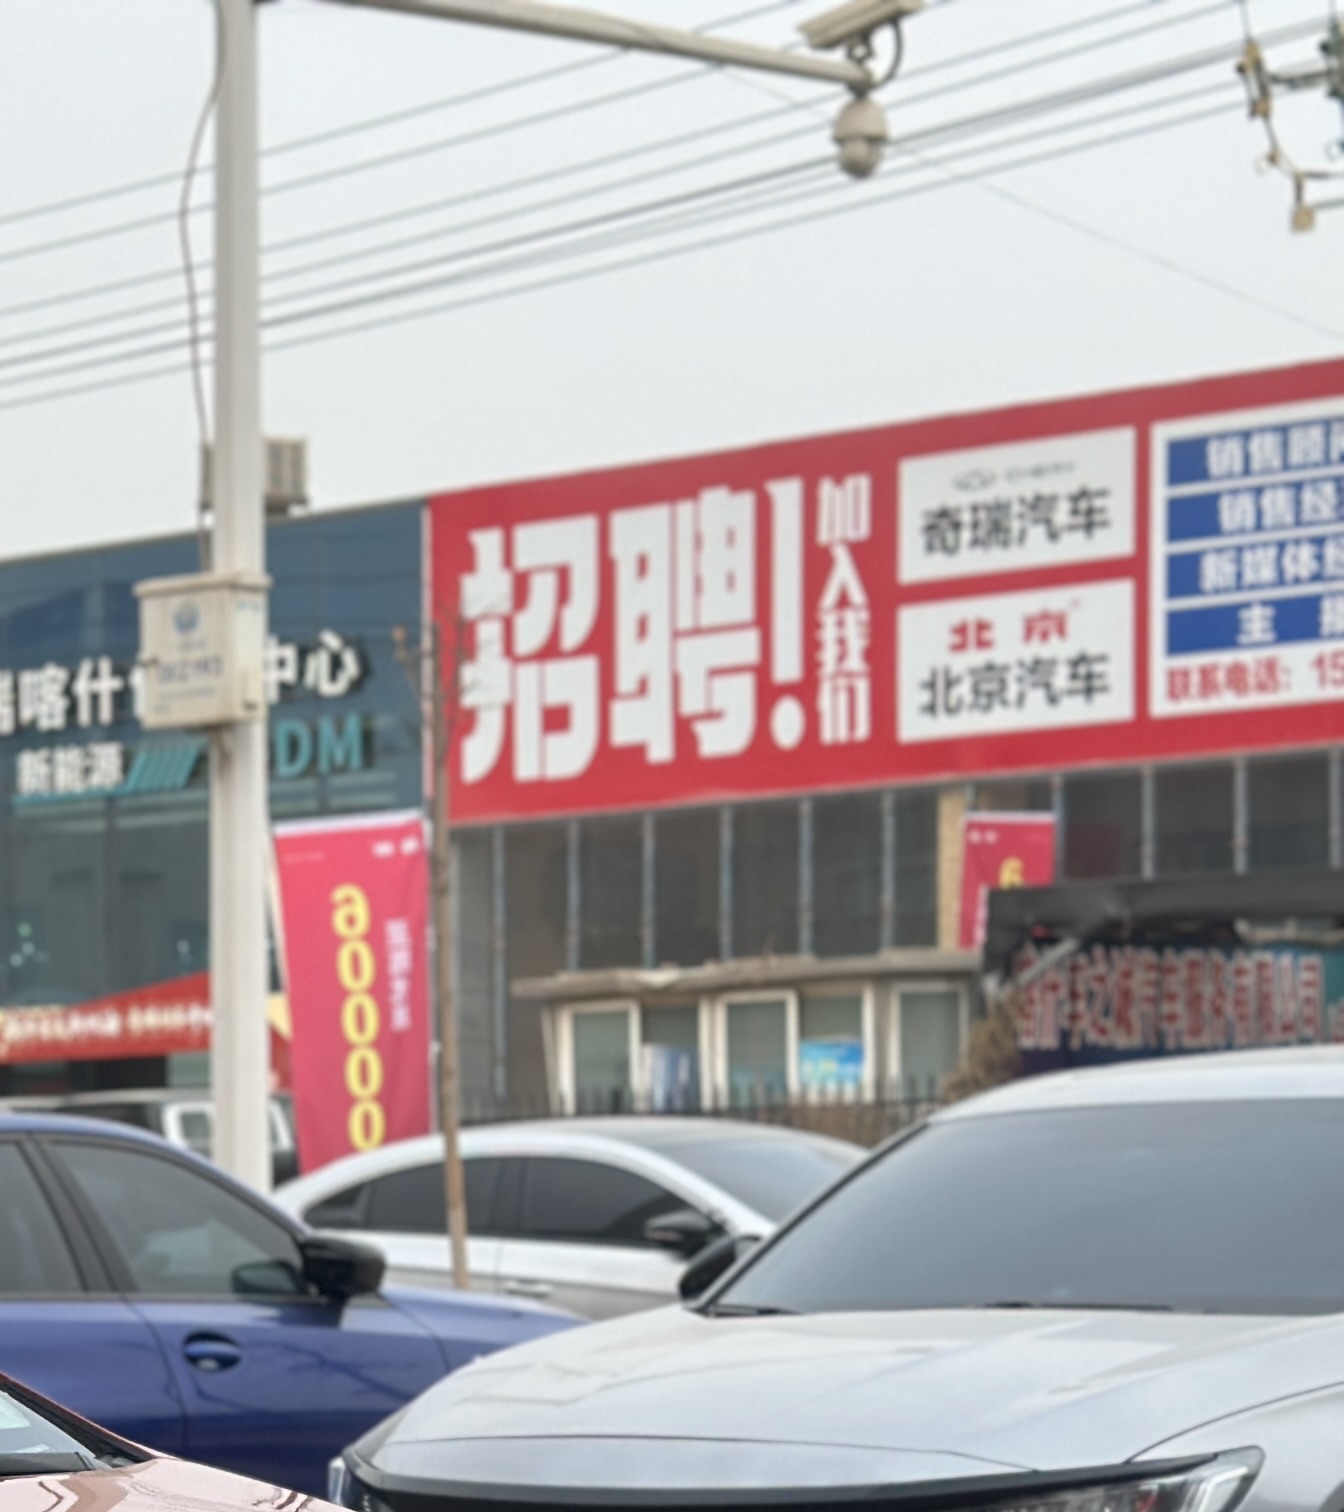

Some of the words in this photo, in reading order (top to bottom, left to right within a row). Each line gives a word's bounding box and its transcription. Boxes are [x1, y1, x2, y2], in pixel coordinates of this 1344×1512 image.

[919, 485, 1111, 557] 奇瑞汽车
[460, 476, 804, 785] 招聘!
[815, 473, 872, 746] 加入我们
[949, 611, 1068, 653] 北京
[919, 651, 1111, 718] 北京汽车
[15, 741, 124, 797] 新能源
